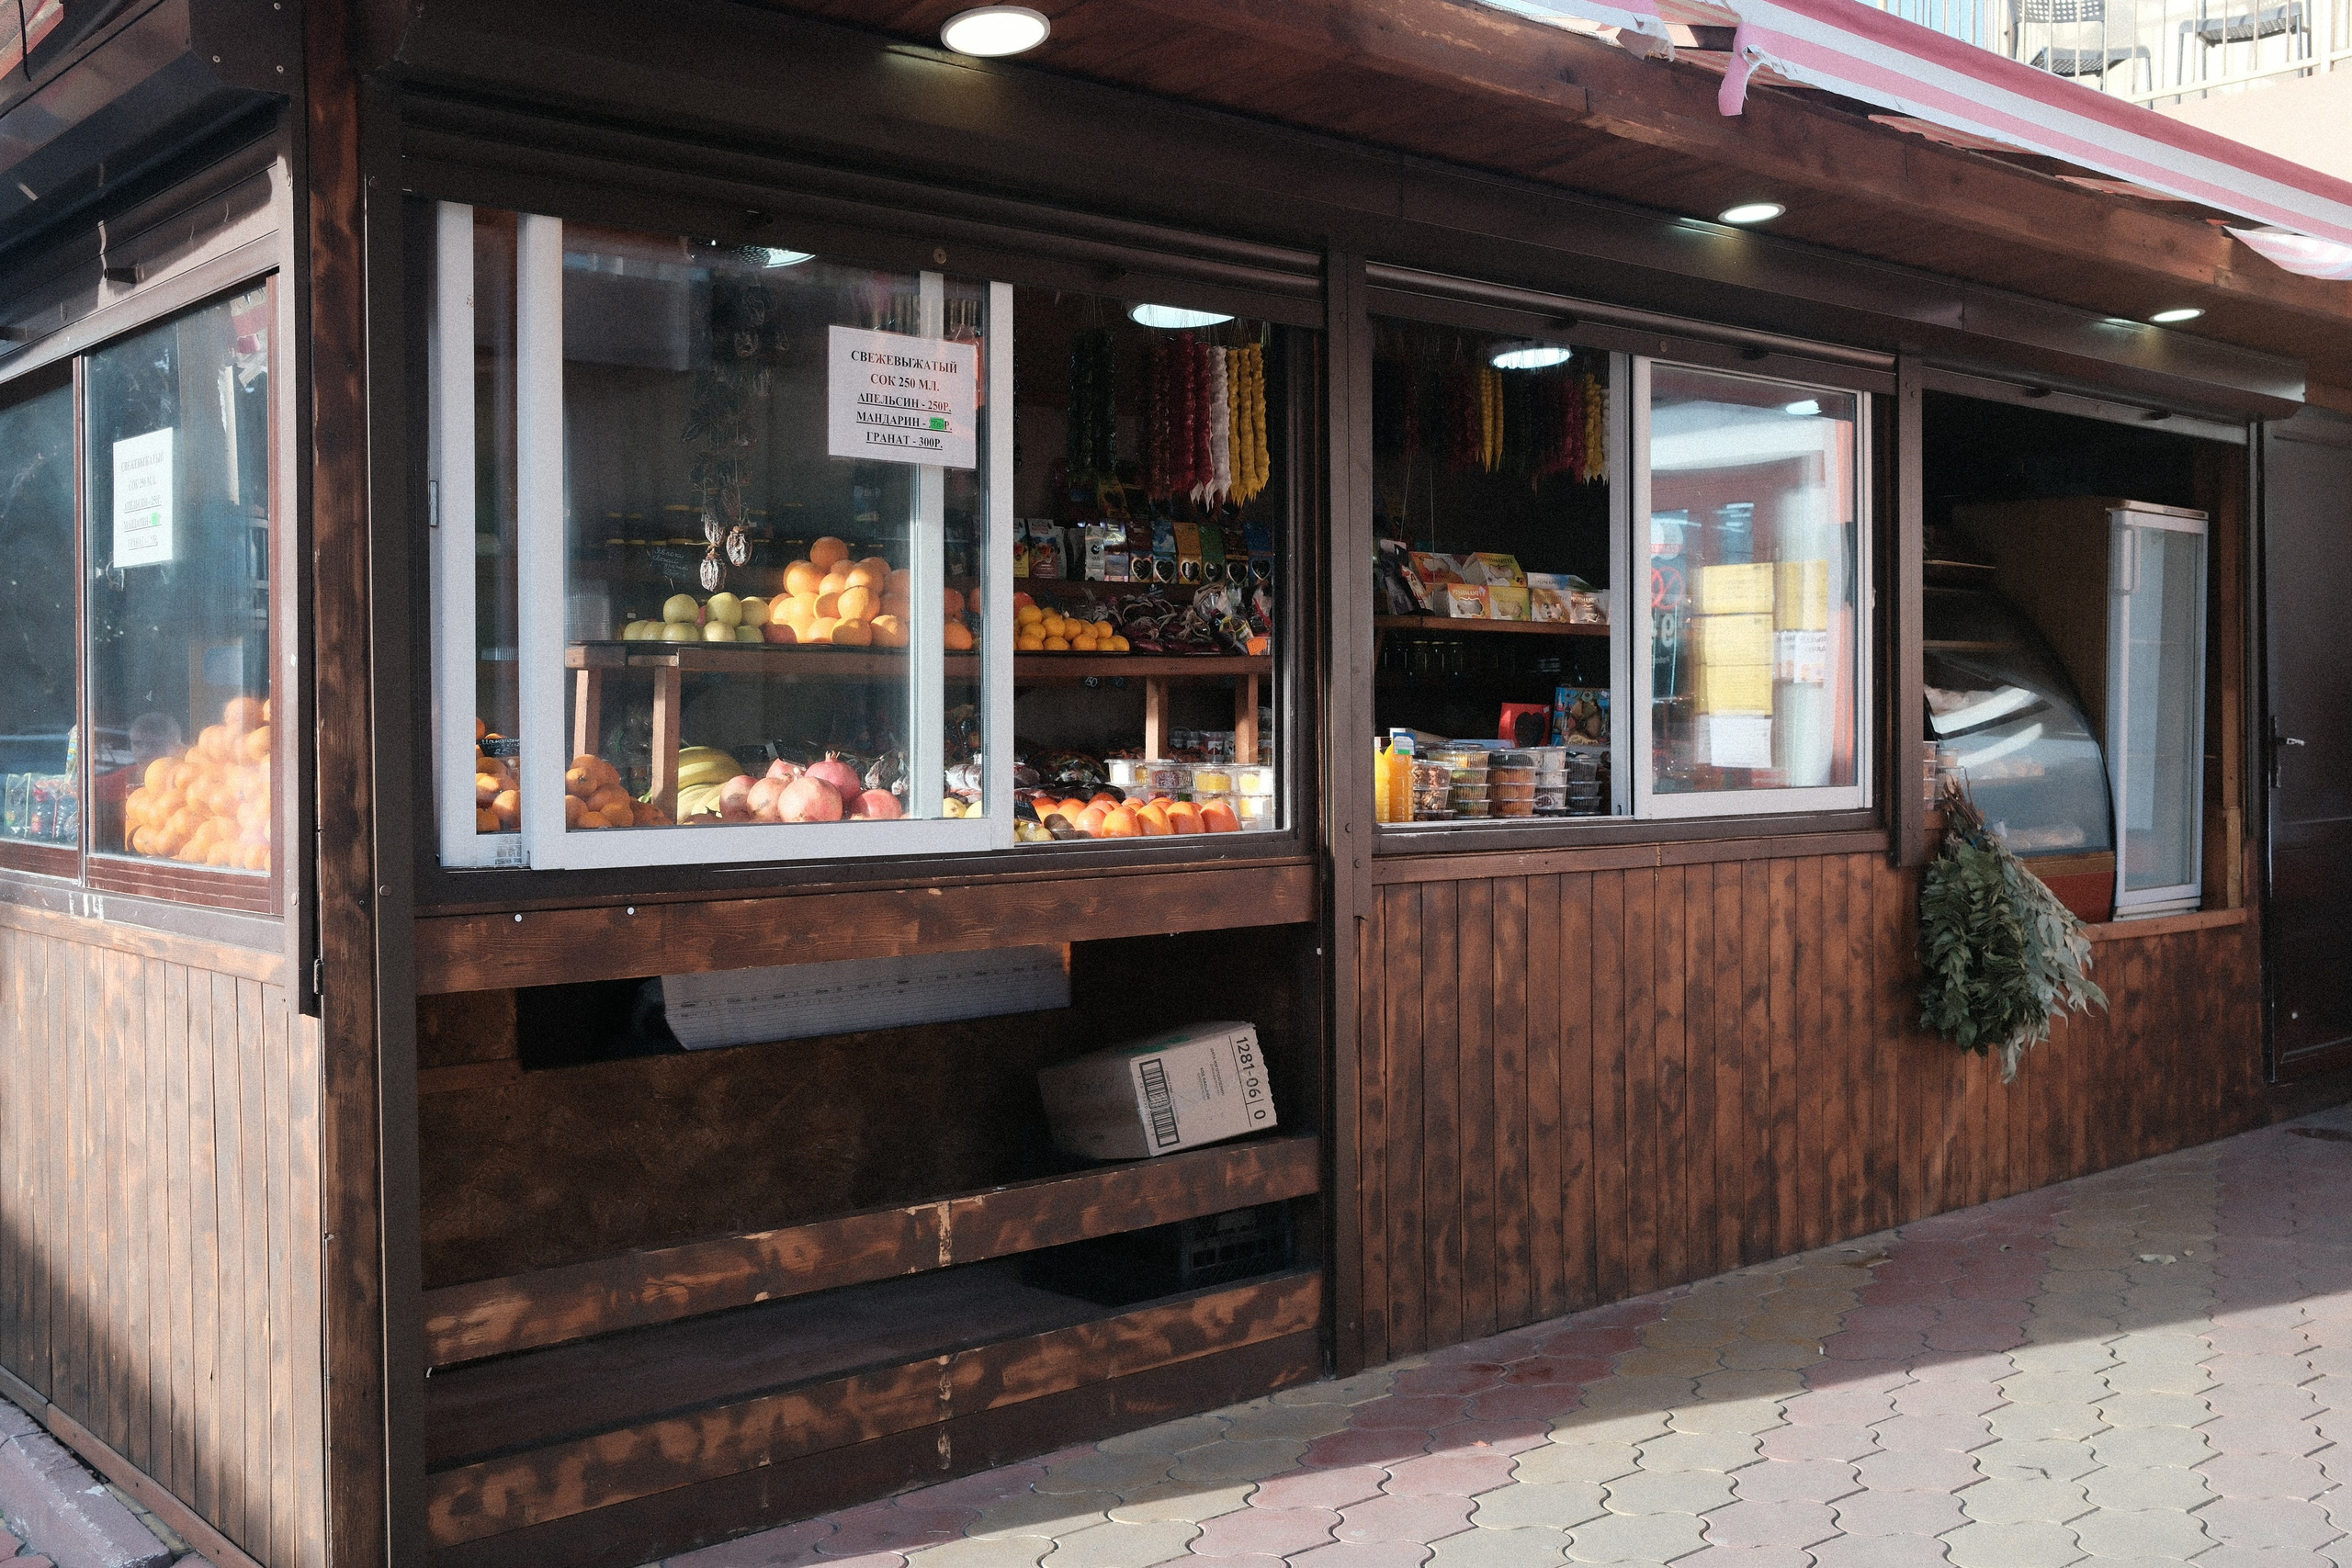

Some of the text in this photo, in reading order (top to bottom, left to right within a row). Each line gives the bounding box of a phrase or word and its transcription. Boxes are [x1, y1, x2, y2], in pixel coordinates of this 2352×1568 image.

[851, 350, 958, 374] СВЕЖЕВЫЖАТЫЙ
[870, 373, 940, 391] СОК 250 МЛ.
[857, 392, 919, 408] АПЕЛЬСИН
[928, 400, 952, 412] 250Р.
[856, 411, 920, 427] МАНДАРИН
[866, 432, 910, 445] ГРАНАТ
[919, 436, 943, 448] 300Р.
[1236, 1036, 1261, 1099] 1281-06
[1253, 1110, 1266, 1120] 0
